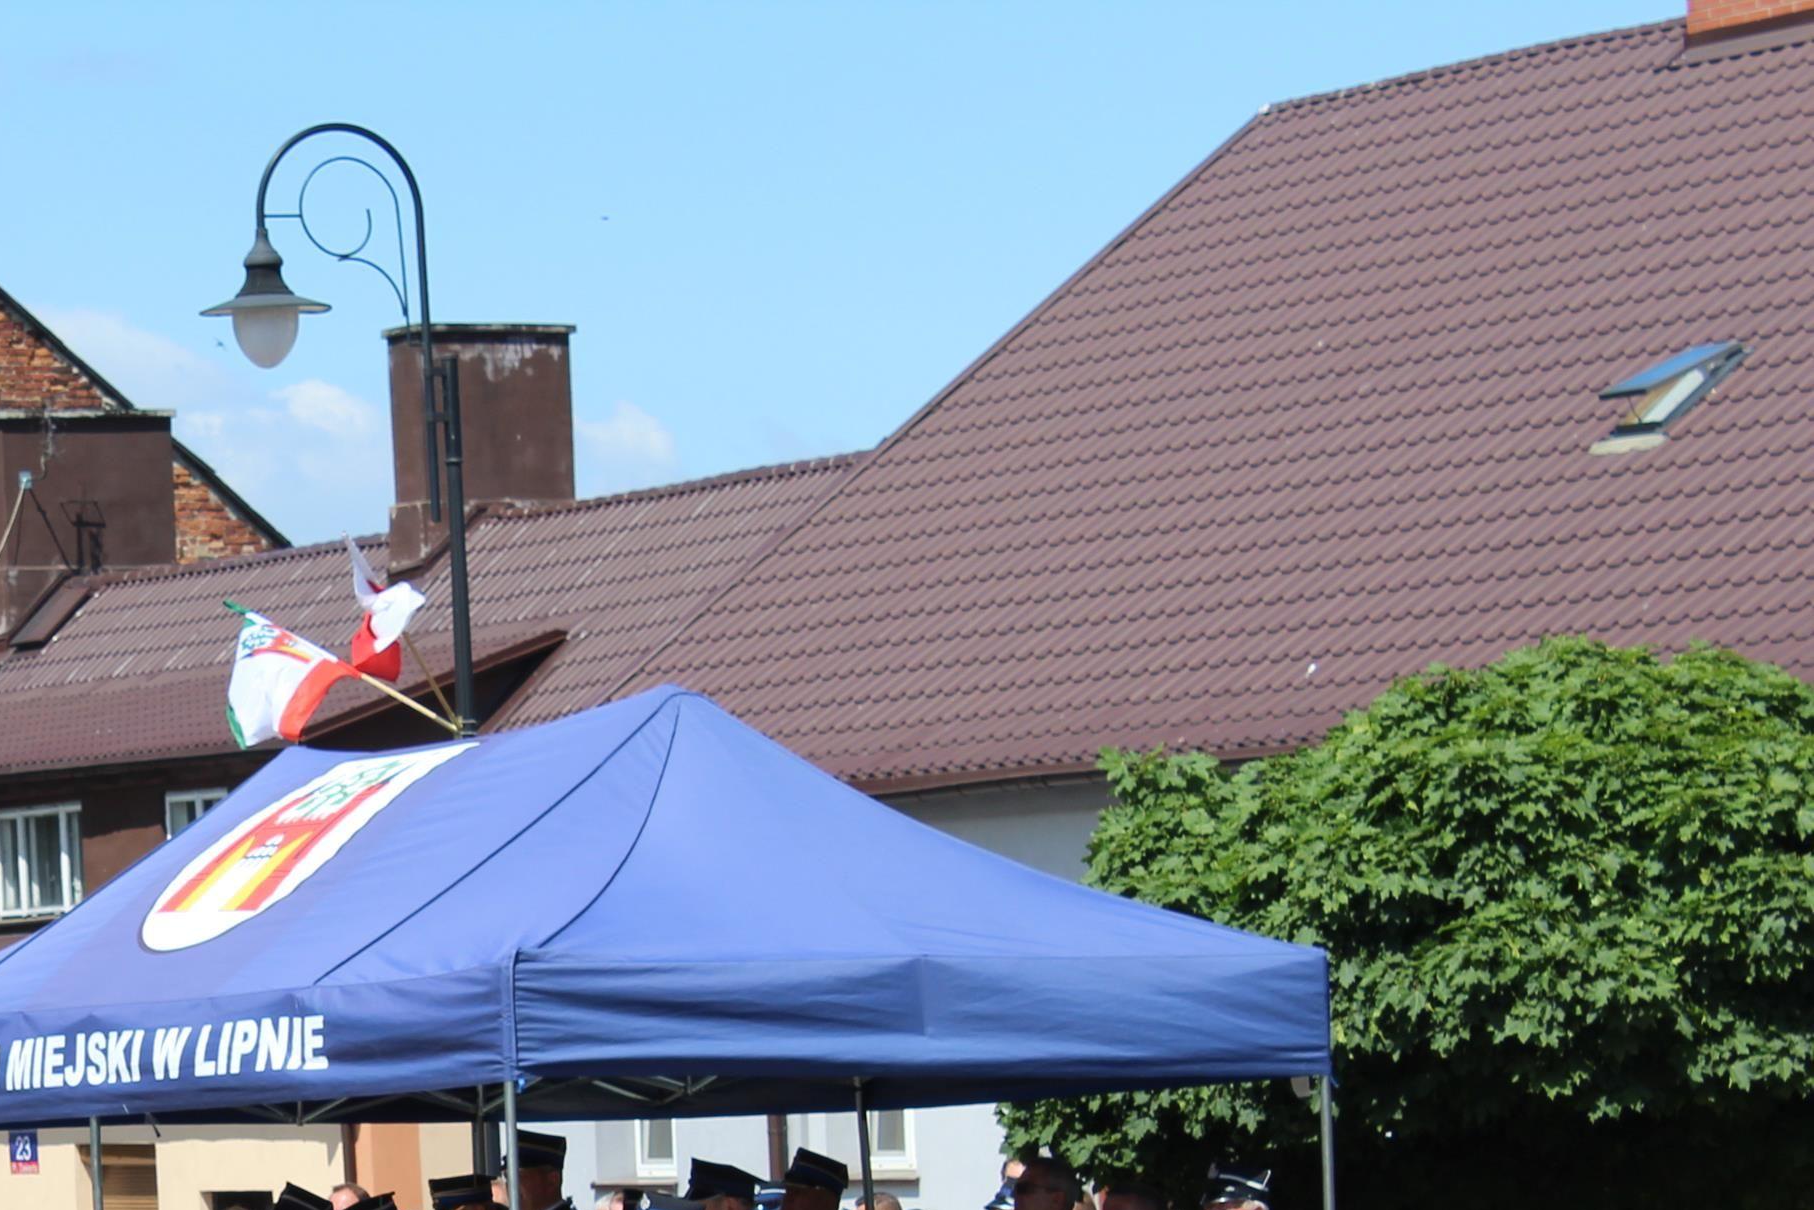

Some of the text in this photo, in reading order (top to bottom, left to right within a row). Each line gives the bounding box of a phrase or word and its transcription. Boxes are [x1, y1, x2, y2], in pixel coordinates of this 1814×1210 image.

[6, 1029, 144, 1091] MIEJSKI
[151, 1026, 192, 1080] W
[194, 1015, 329, 1077] LIPNIE
[15, 1135, 32, 1161] 23
